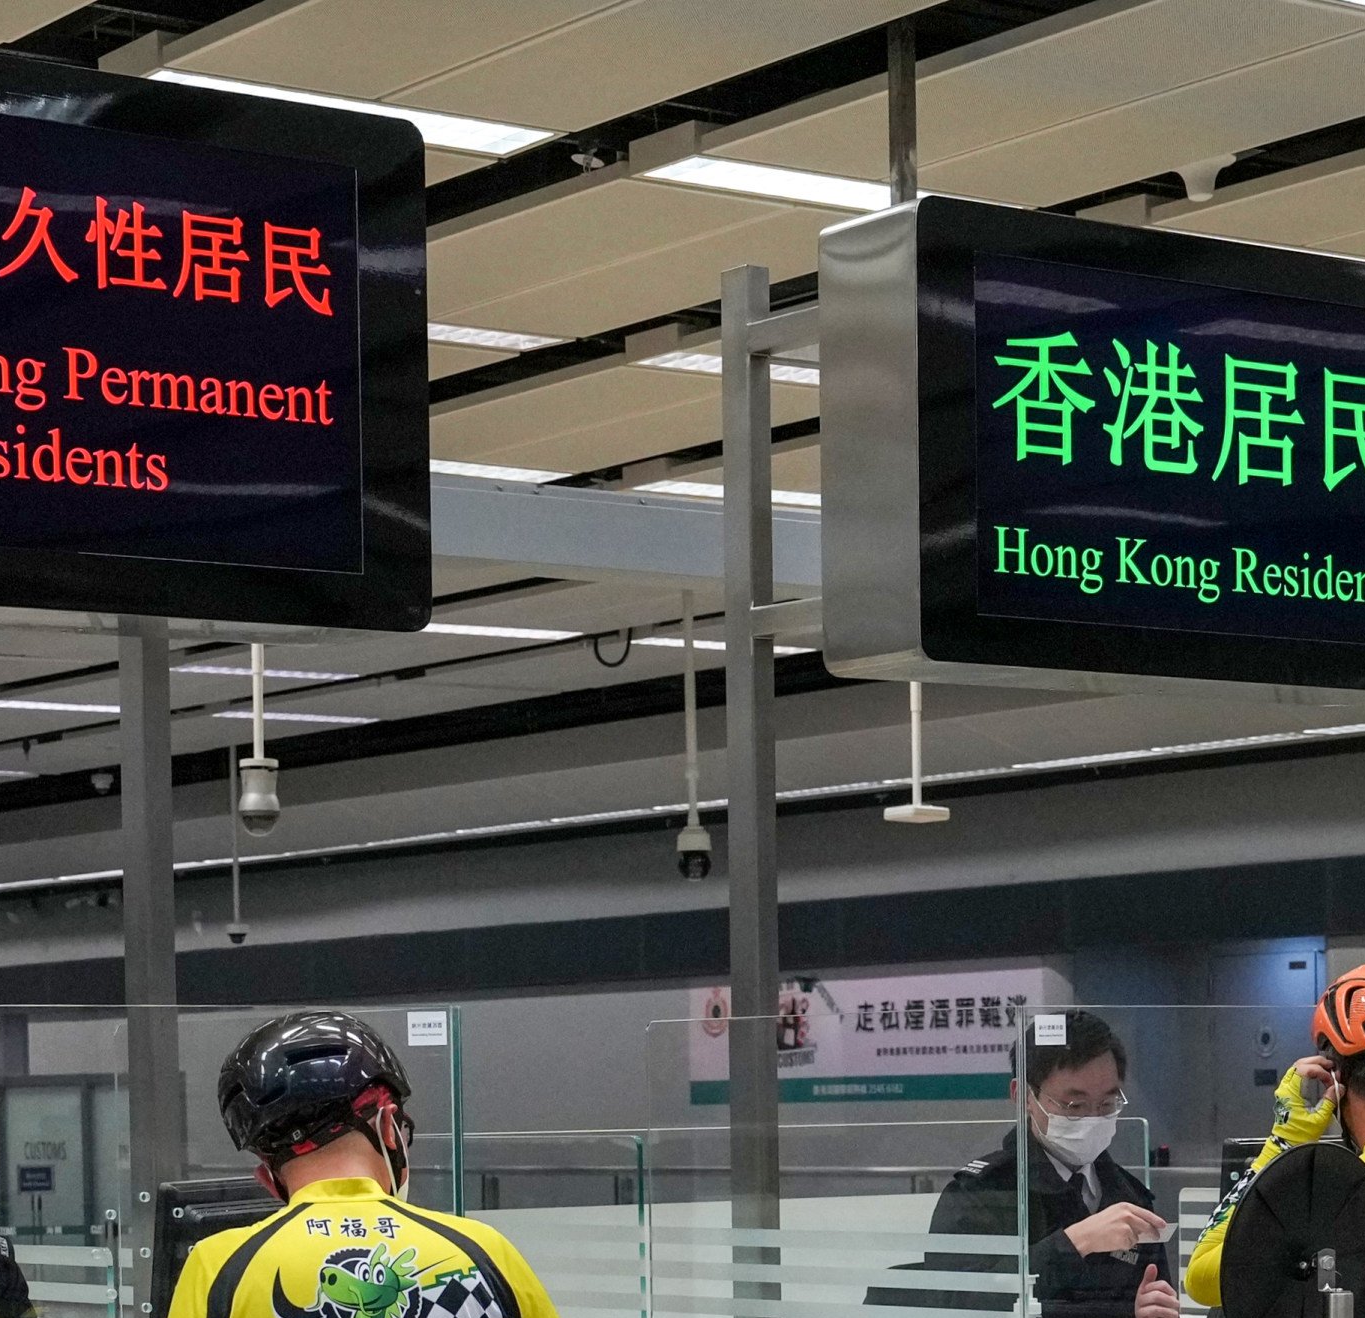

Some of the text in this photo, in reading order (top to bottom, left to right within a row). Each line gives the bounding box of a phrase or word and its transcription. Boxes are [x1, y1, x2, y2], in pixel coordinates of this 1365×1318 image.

[62, 347, 334, 426] Permanent
[995, 526, 1104, 594] Hong
[1117, 537, 1221, 604] Kong
[306, 1217, 401, 1239] 阿福哥
